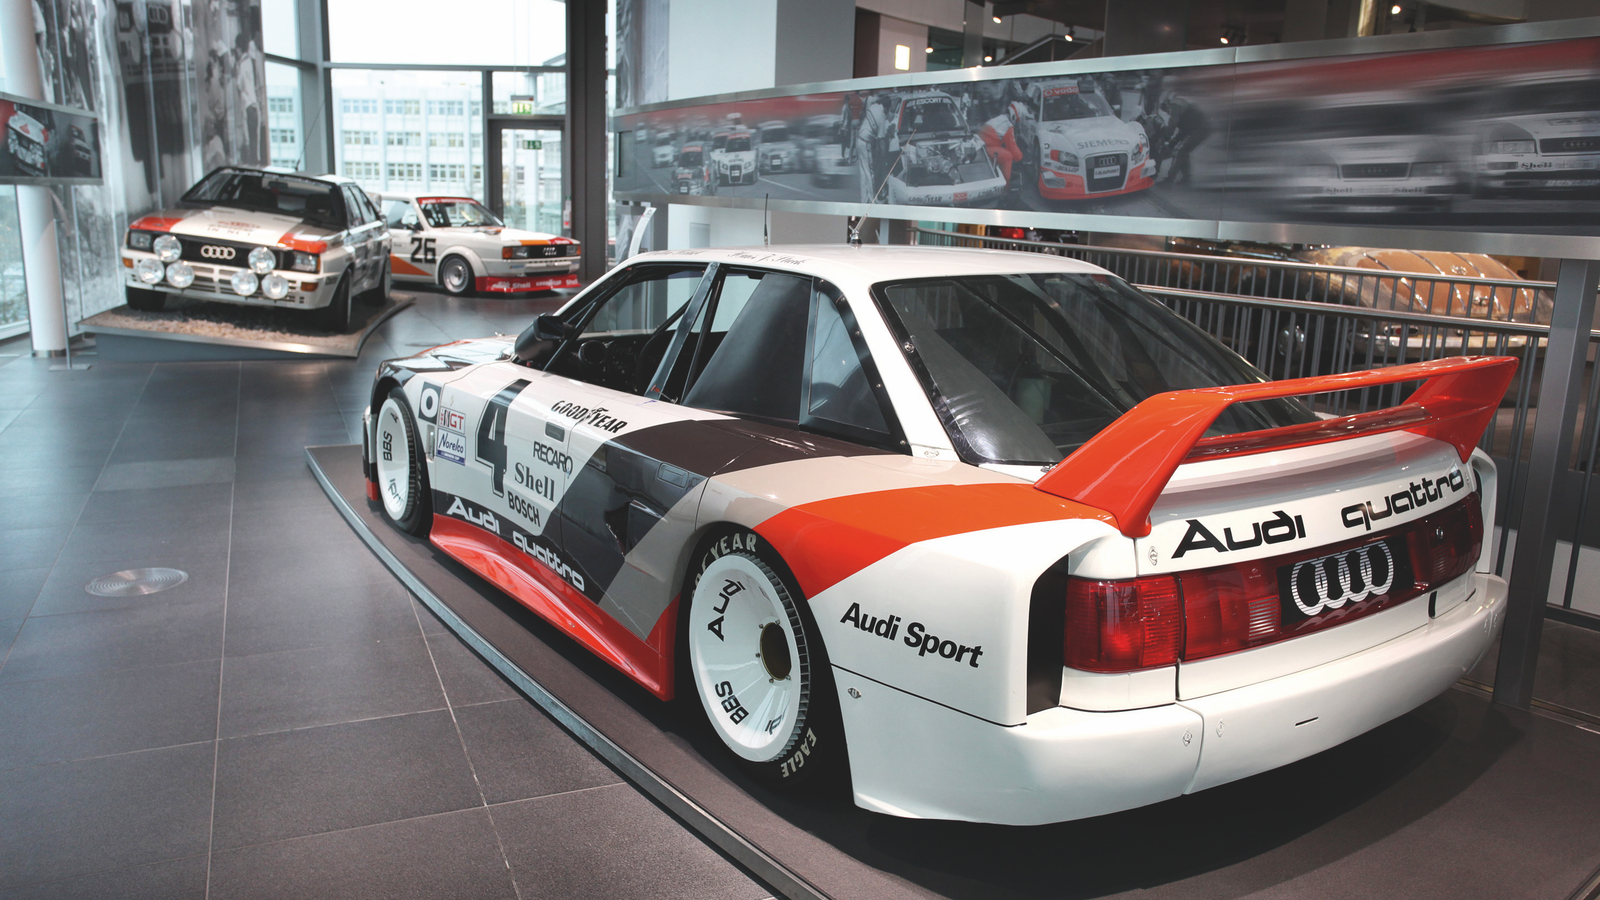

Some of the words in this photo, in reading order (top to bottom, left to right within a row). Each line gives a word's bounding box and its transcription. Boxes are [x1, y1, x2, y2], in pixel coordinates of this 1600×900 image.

[1077, 139, 1130, 150] SIEMENS
[1520, 162, 1552, 170] Shell
[410, 237, 437, 264] 26
[551, 400, 628, 435] GOODYEAR
[382, 430, 393, 462] BBS
[438, 432, 464, 454] Norelco
[475, 378, 532, 498] 4
[533, 441, 573, 475] RECARO
[514, 462, 556, 502] Shell
[507, 490, 541, 527] BOSCH
[1171, 510, 1307, 559] Audi
[1340, 467, 1465, 531] quattro
[446, 496, 500, 535] Audi
[512, 530, 585, 592] quattro
[707, 578, 747, 642] Audi
[840, 602, 902, 641] Audi
[903, 621, 984, 669] Sport
[714, 679, 750, 726] BBS
[780, 726, 817, 778] EAGLE
